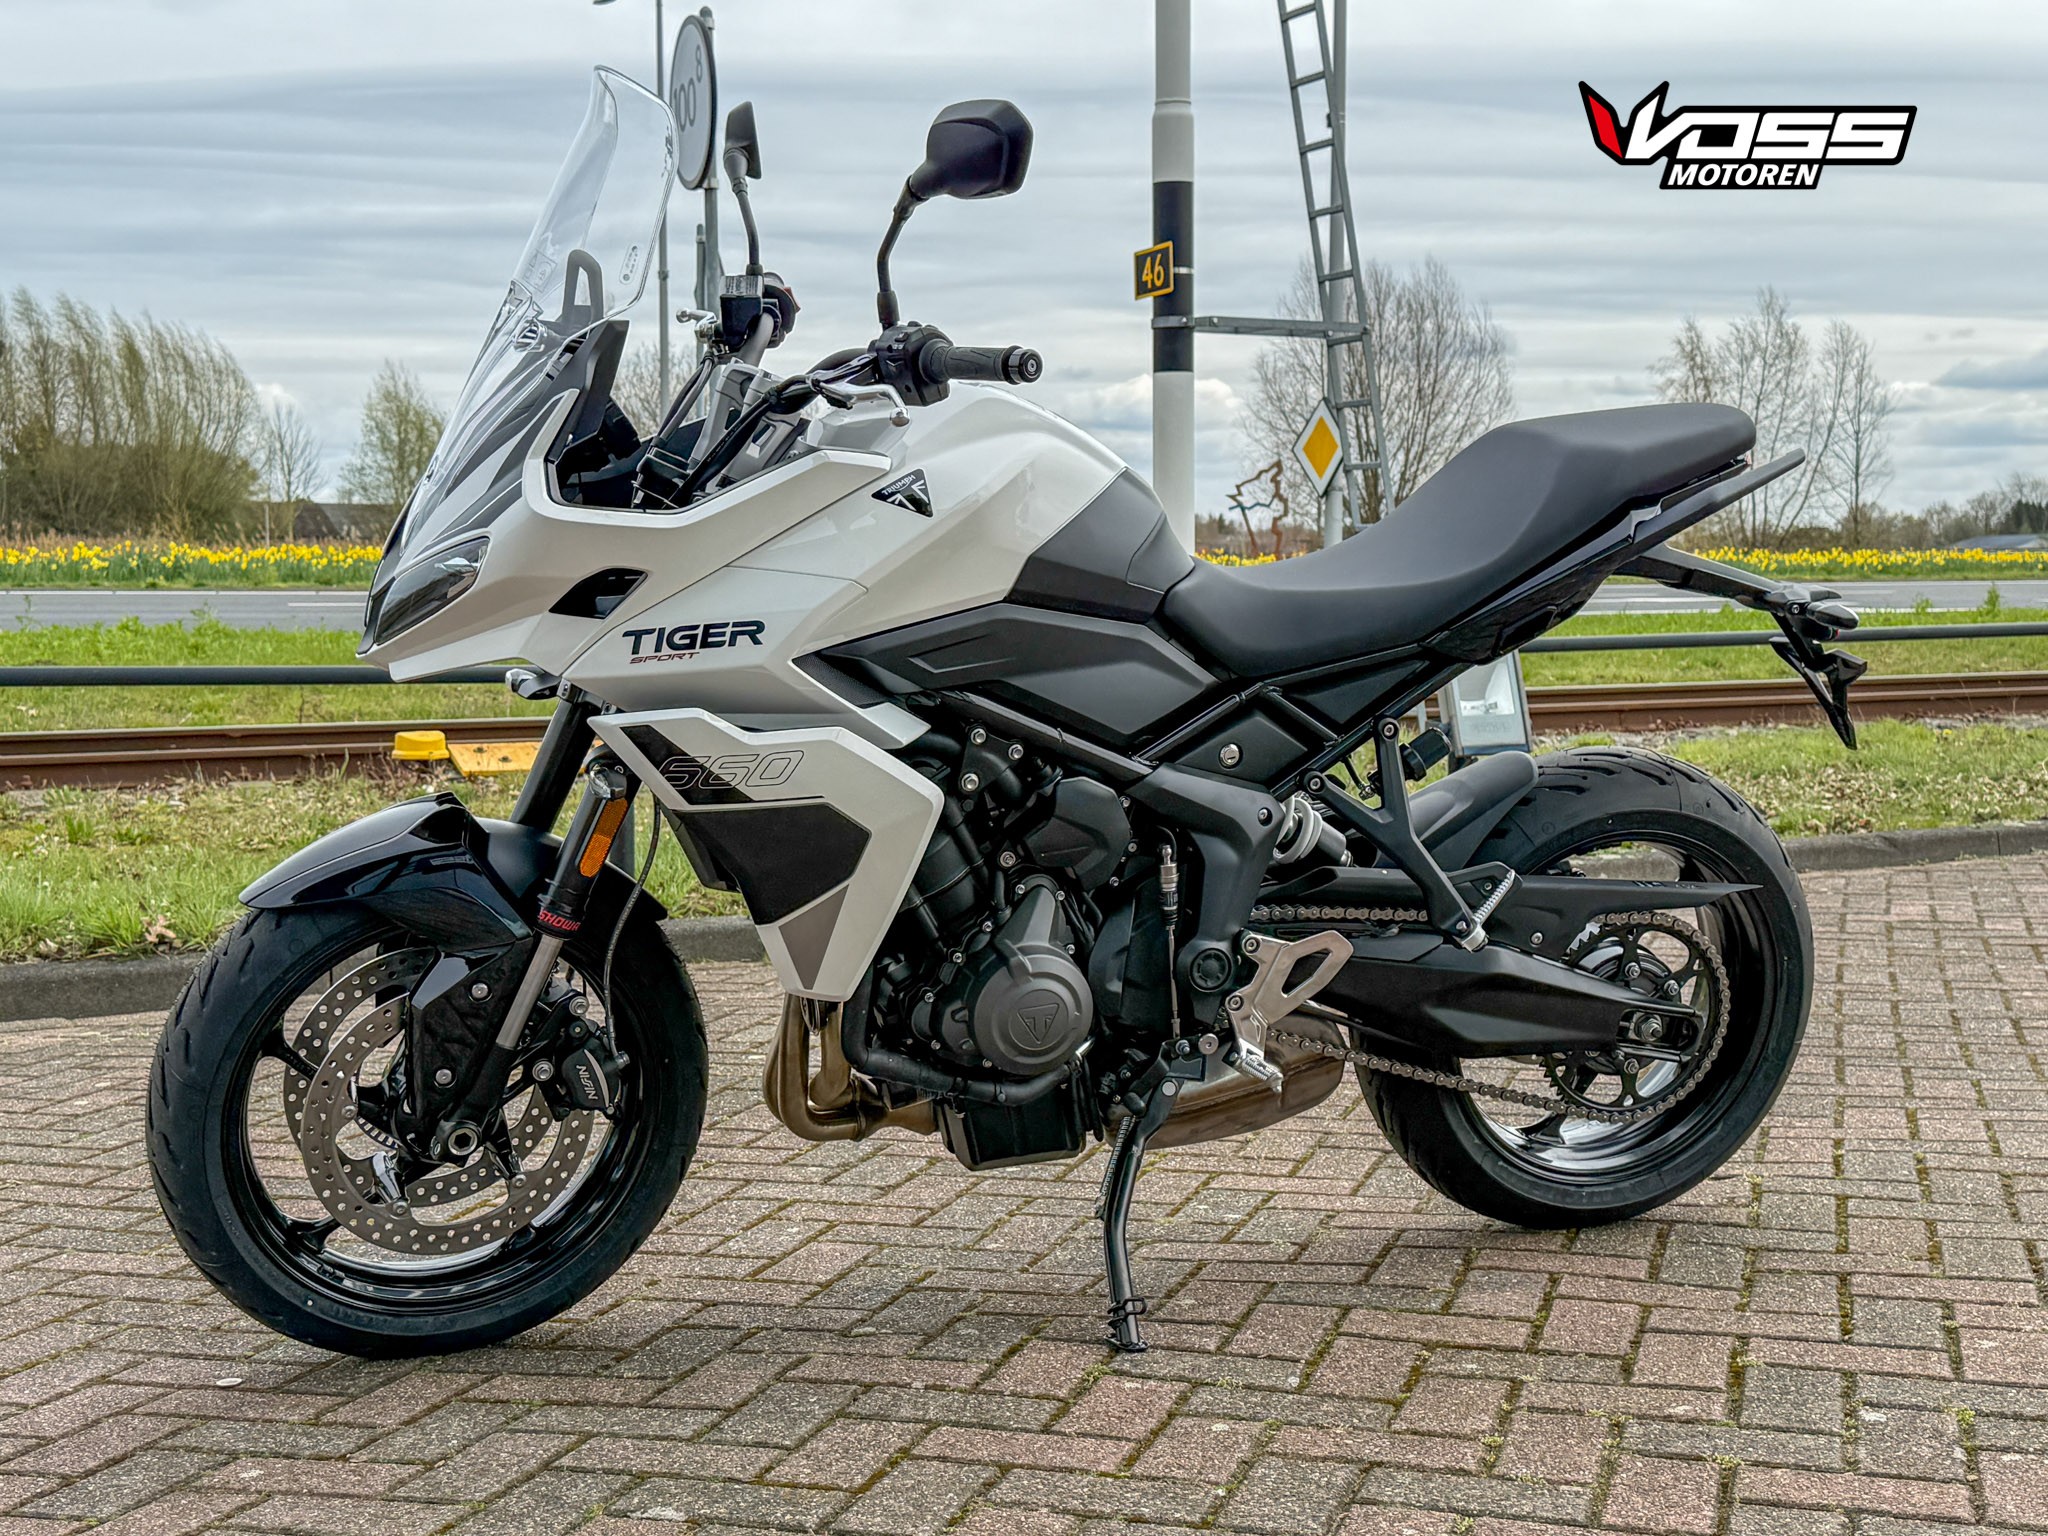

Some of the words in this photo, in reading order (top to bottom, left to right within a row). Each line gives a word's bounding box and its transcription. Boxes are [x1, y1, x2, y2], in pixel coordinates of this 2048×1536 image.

[695, 44, 703, 83] 8
[1142, 253, 1165, 289] 46
[881, 474, 917, 496] TRIUMPH
[622, 620, 766, 655] TIGER
[629, 652, 700, 664] SPORT
[658, 750, 805, 790] 660
[538, 910, 581, 931] SHOWA
[575, 1064, 599, 1100] NISSIN
